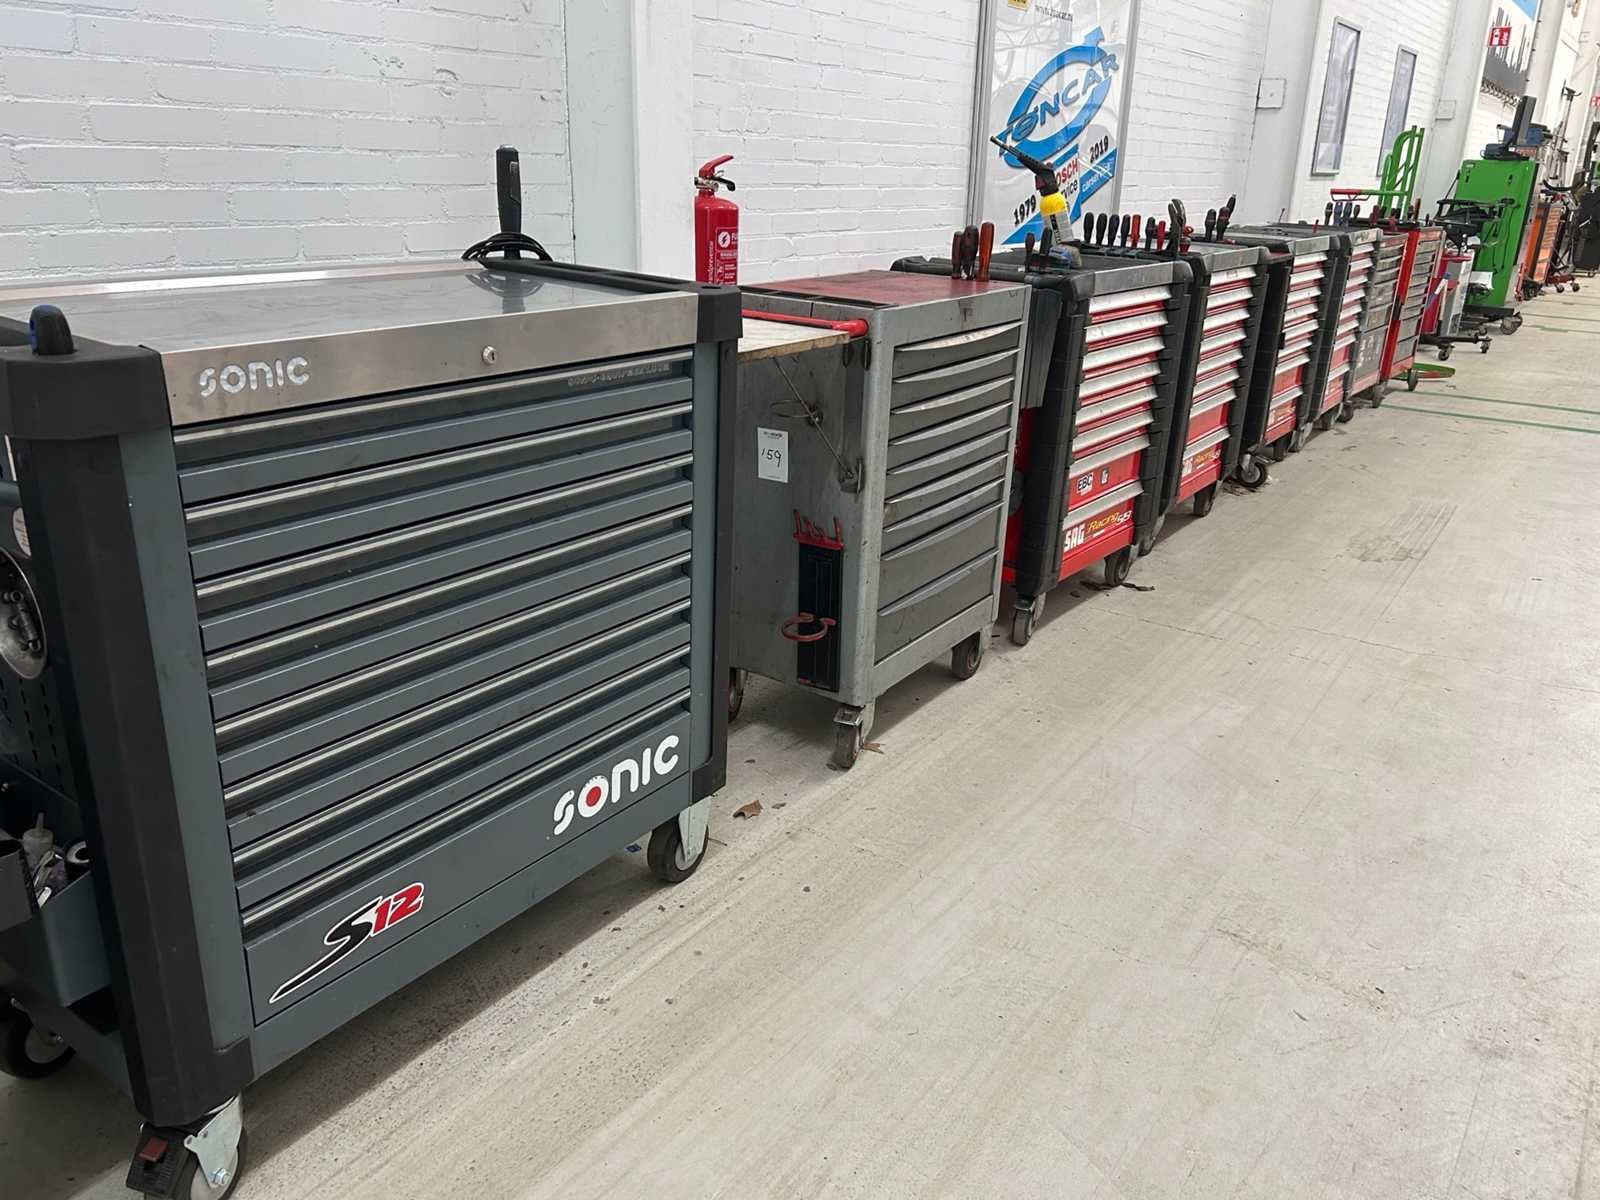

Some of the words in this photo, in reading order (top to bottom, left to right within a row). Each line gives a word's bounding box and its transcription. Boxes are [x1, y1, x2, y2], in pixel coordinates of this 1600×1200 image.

[1090, 135, 1109, 164] 2019
[1055, 157, 1079, 188] OSCH
[1013, 194, 1036, 227] 1979
[762, 447, 782, 468] 159
